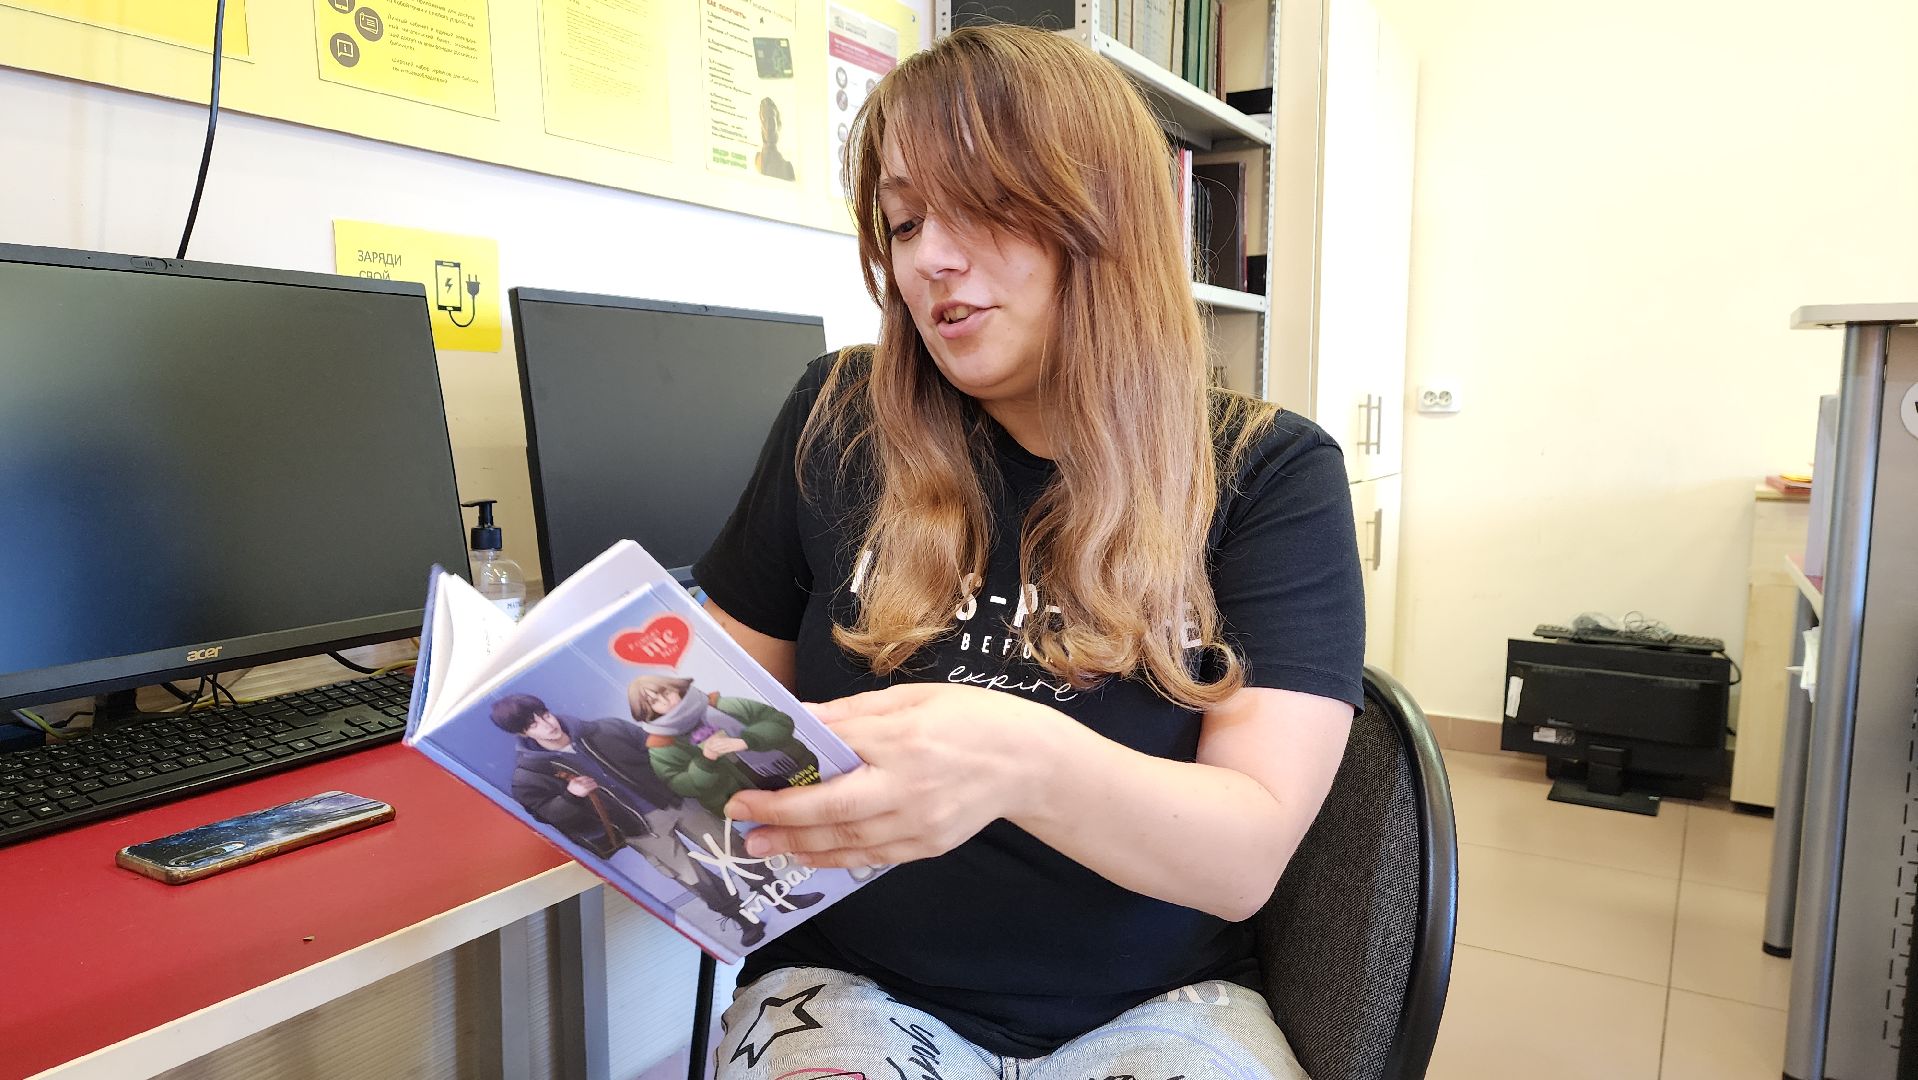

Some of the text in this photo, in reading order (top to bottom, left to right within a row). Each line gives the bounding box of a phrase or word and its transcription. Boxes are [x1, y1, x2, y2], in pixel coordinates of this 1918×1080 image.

[358, 250, 402, 267] ЗАРЯДИ
[186, 645, 223, 662] acer
[948, 665, 1078, 701] expire
